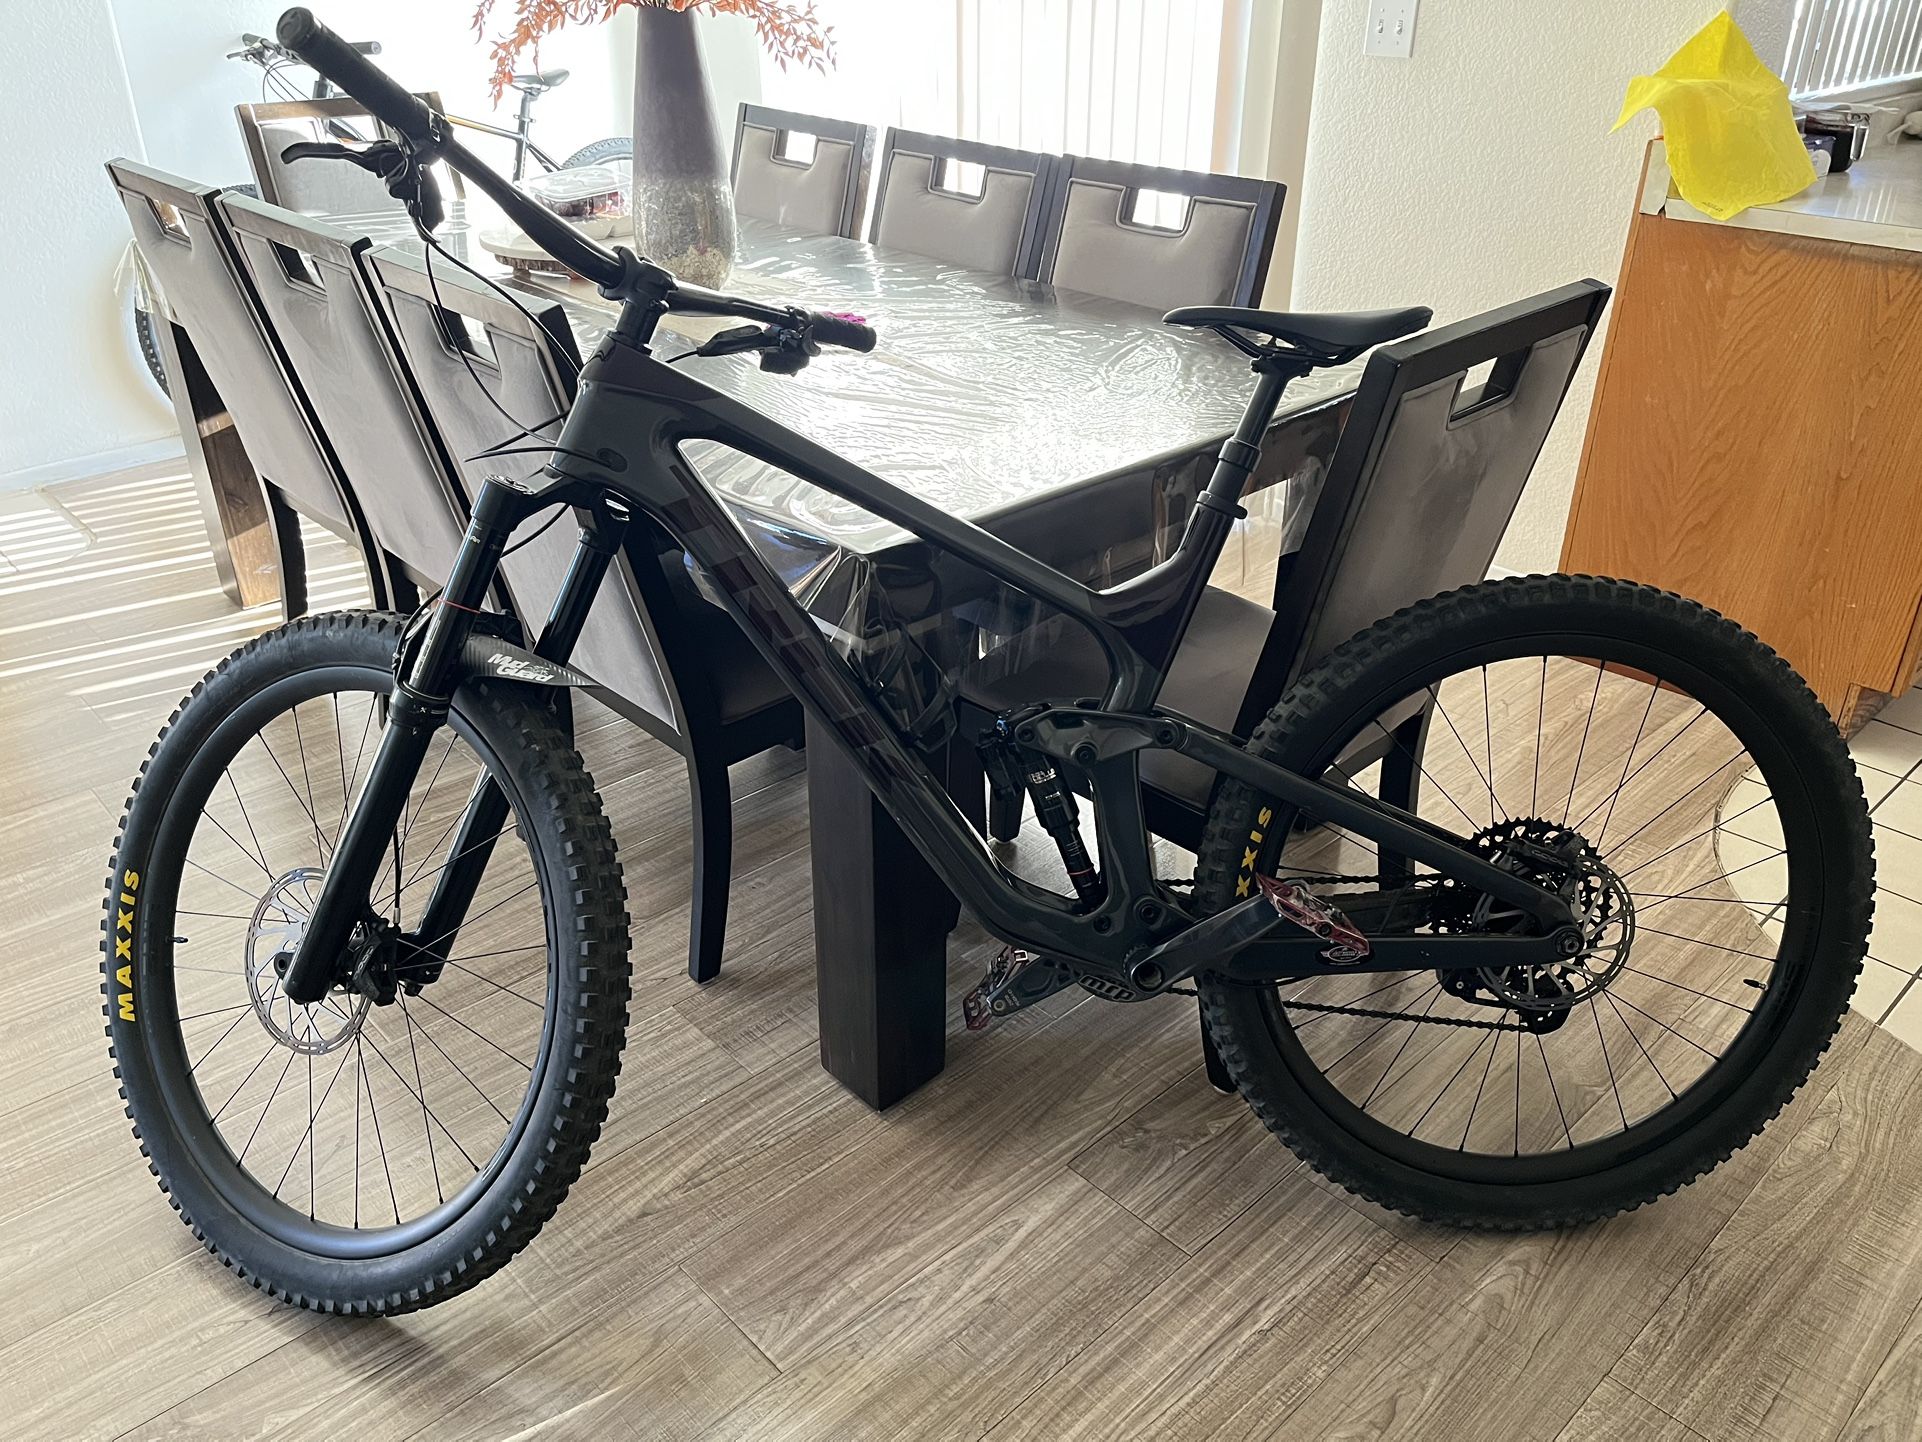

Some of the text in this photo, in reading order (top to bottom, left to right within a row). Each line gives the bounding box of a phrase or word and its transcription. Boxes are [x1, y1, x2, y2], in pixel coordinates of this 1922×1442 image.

[661, 465, 924, 792] TREK
[488, 654, 530, 668] Mud
[496, 664, 554, 682] Guard
[1235, 806, 1272, 897] XXIS
[116, 868, 139, 1022] MAXXIS
[1080, 975, 1134, 1000] mrp
